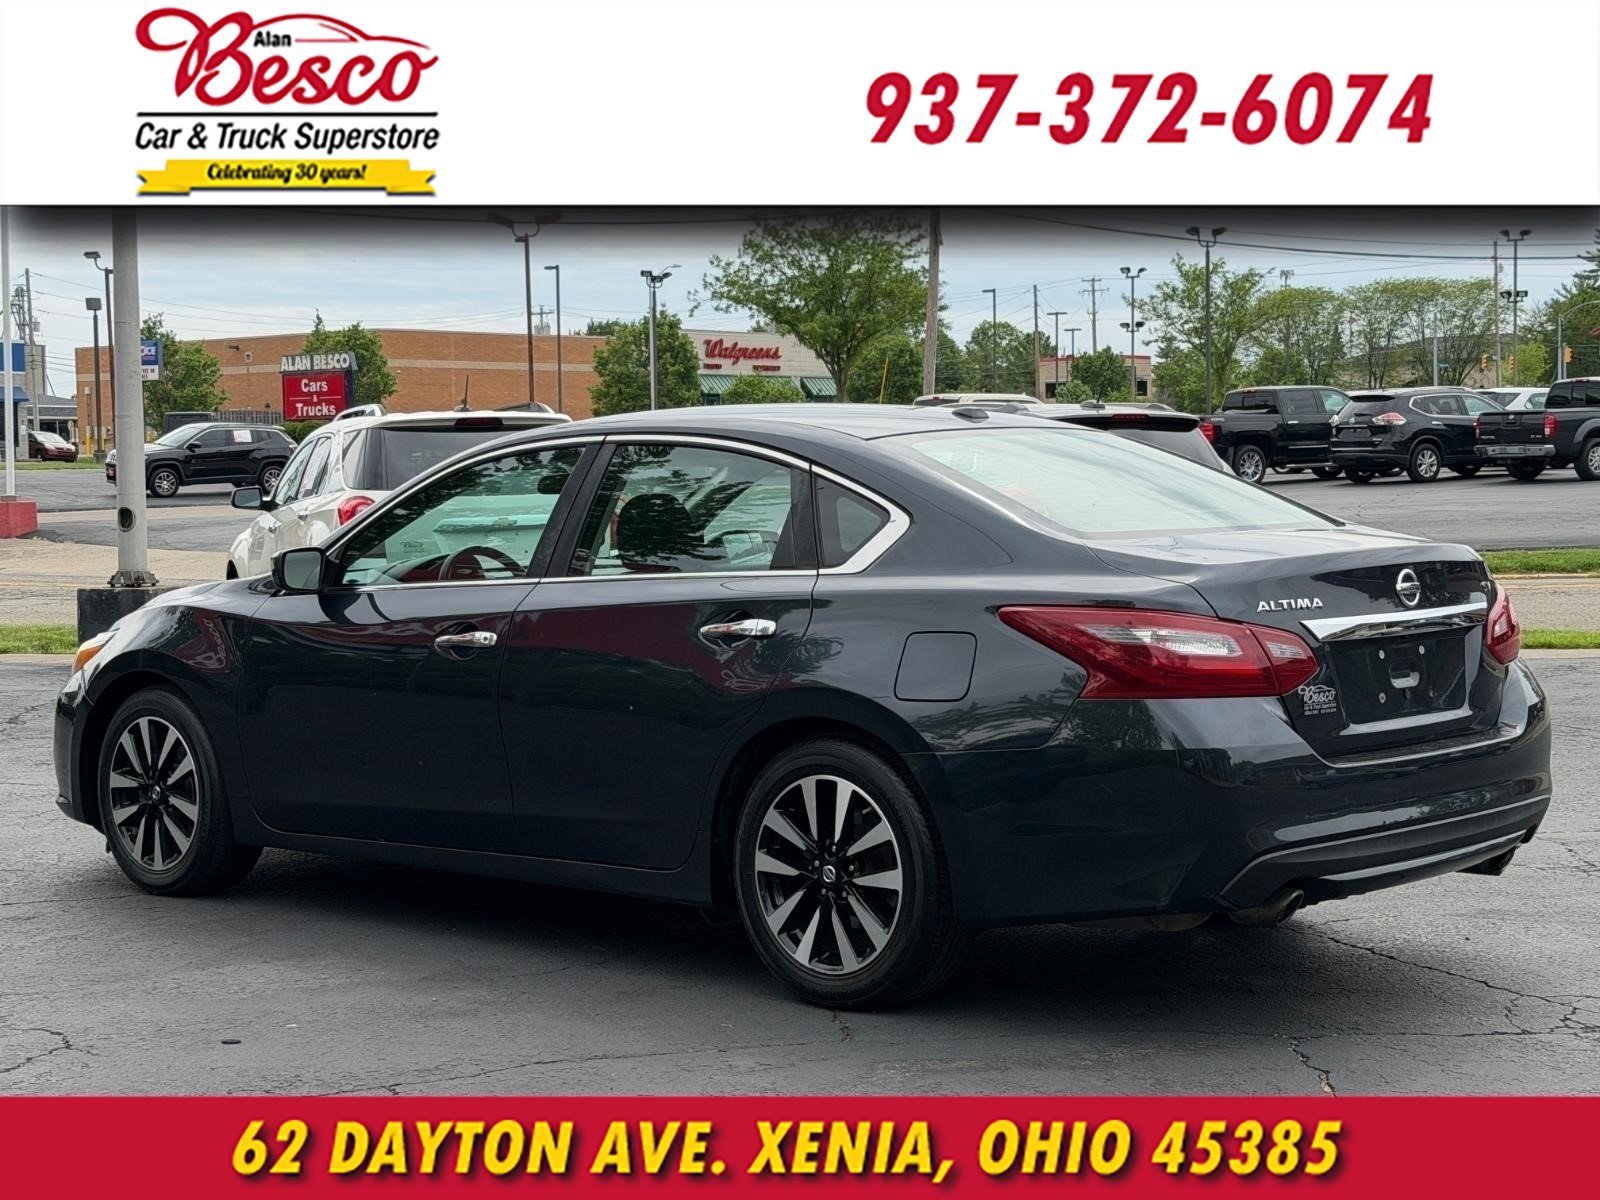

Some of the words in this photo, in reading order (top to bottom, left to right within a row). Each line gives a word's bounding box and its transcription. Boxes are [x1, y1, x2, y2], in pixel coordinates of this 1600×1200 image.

[703, 338, 783, 365] Walgreens
[280, 356, 311, 372] ALAN
[313, 353, 350, 370] BESCO
[301, 378, 329, 393] Cars
[296, 402, 337, 417] Trucks
[1256, 598, 1324, 613] ALTIMA
[1298, 685, 1337, 704] Besco
